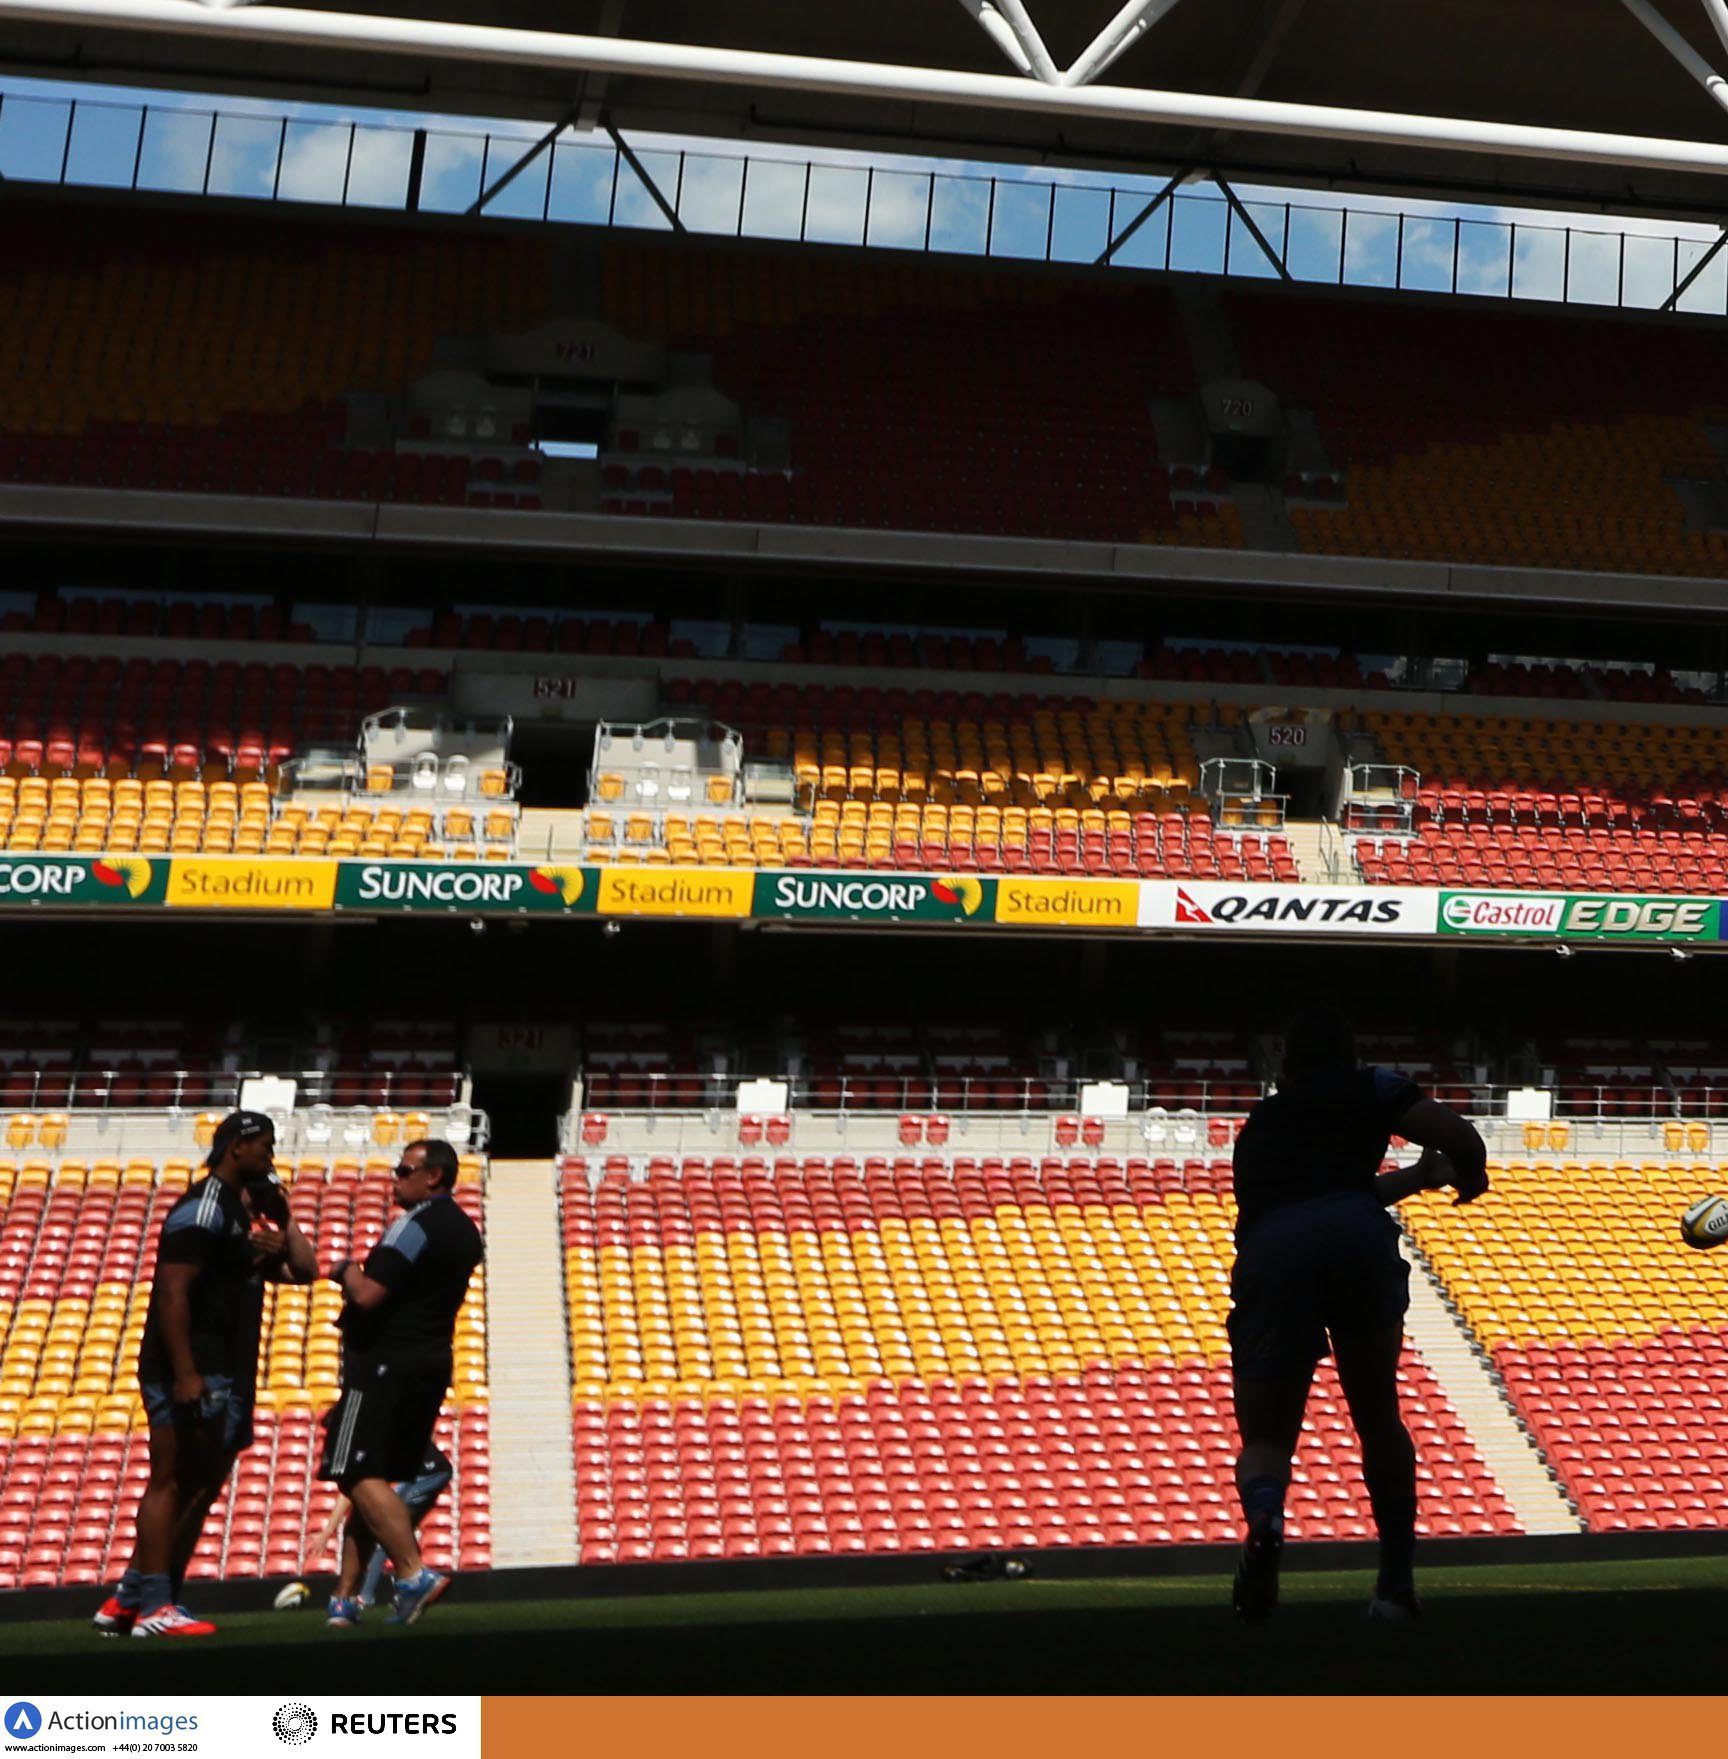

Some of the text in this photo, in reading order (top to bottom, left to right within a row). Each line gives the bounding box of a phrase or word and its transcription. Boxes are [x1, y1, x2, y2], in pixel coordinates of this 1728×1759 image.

[1222, 399, 1254, 417] 720
[1270, 726, 1305, 745] 520
[181, 868, 314, 897] Stadium
[358, 866, 523, 901] SUNCORP
[610, 878, 733, 905] Stadium
[774, 876, 926, 911] SUNCORP
[1007, 889, 1122, 915] Stadium
[1211, 896, 1403, 924] QANTAS
[1473, 900, 1713, 932] Castrol EDGE
